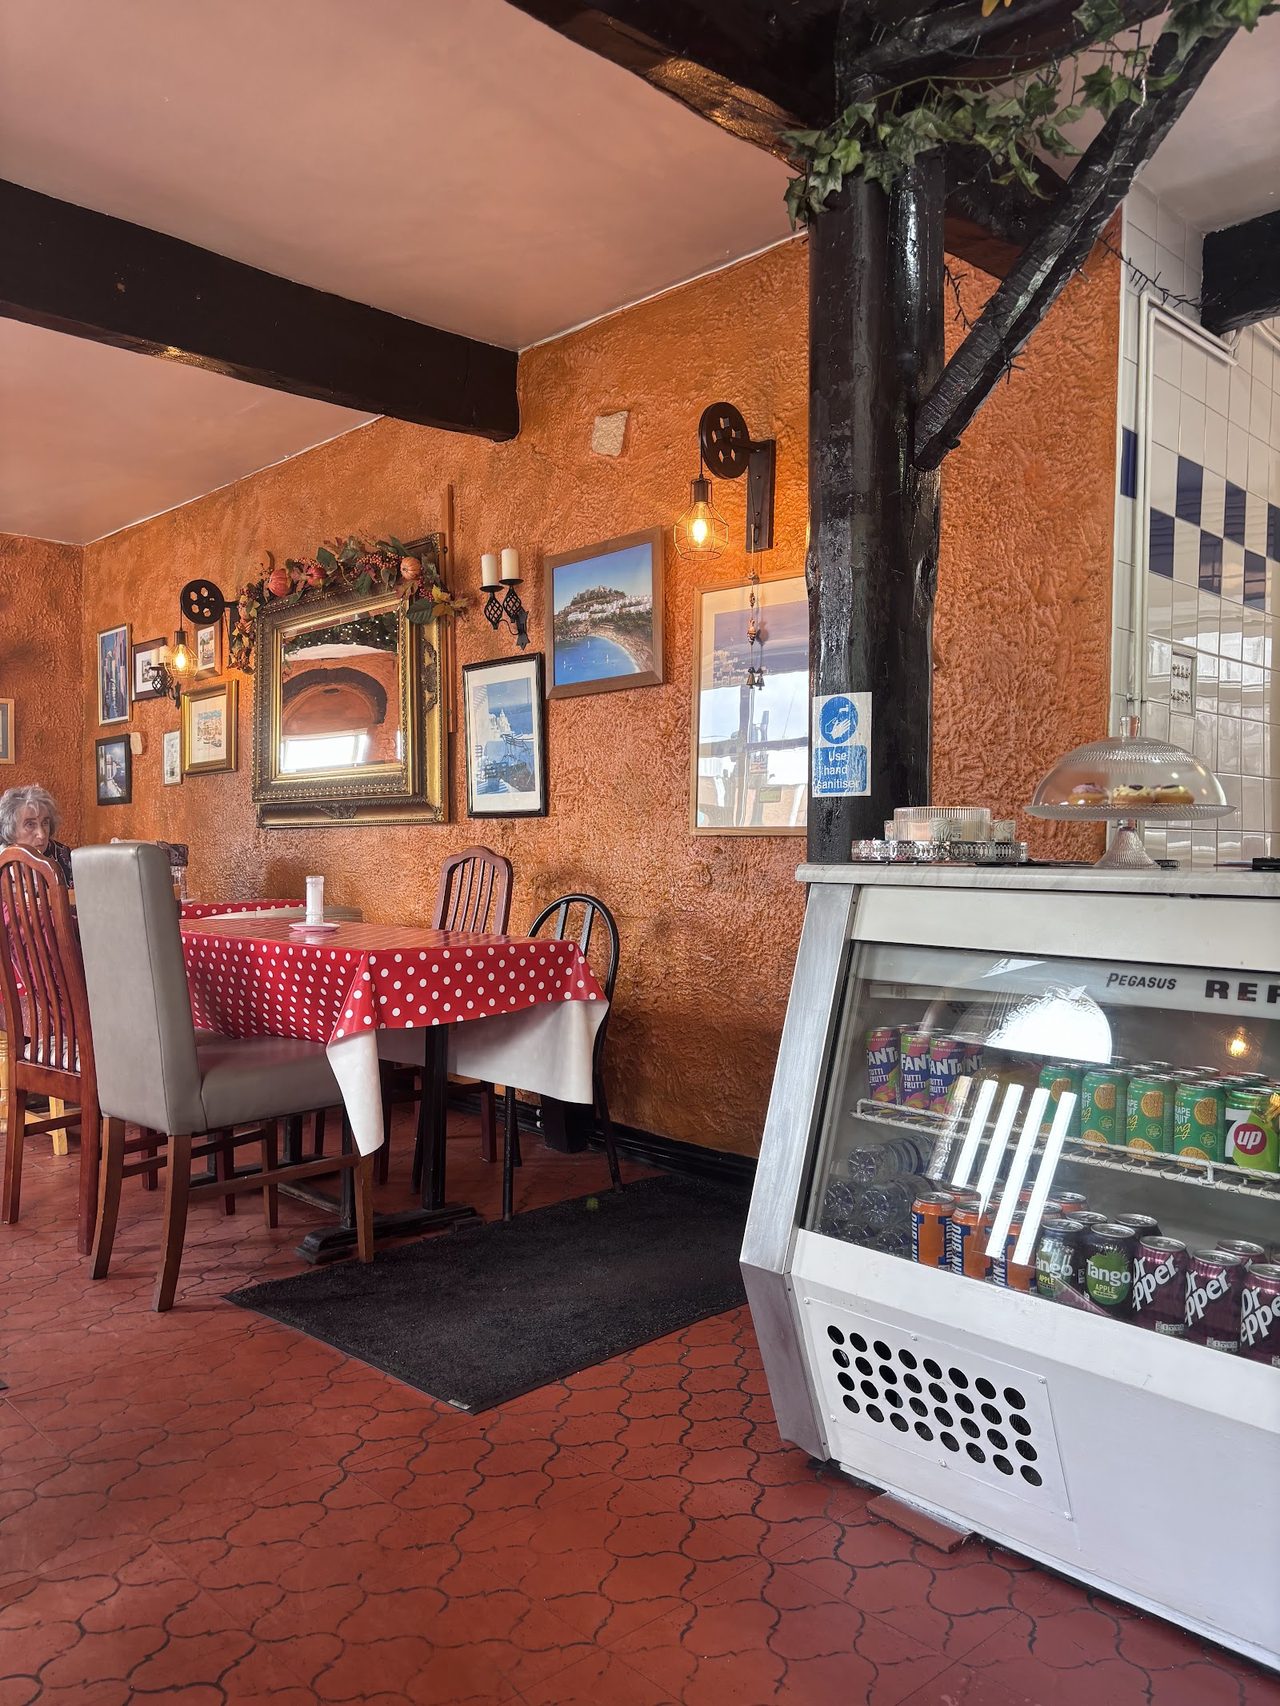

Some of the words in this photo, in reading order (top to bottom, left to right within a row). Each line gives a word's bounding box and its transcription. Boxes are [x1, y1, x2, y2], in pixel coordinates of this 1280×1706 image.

[828, 751, 847, 762] Use
[823, 765, 848, 776] hand
[817, 779, 861, 790] sanitiser
[1106, 972, 1177, 990] PEGASUS
[930, 1058, 963, 1076] ANTA
[903, 1073, 922, 1082] TUTTI
[903, 1081, 926, 1089] FRUTTI
[929, 1085, 948, 1094] RUTTI
[1036, 1256, 1073, 1279] ango
[1086, 1258, 1131, 1287] Tango
[1095, 1283, 1115, 1293] APPLE
